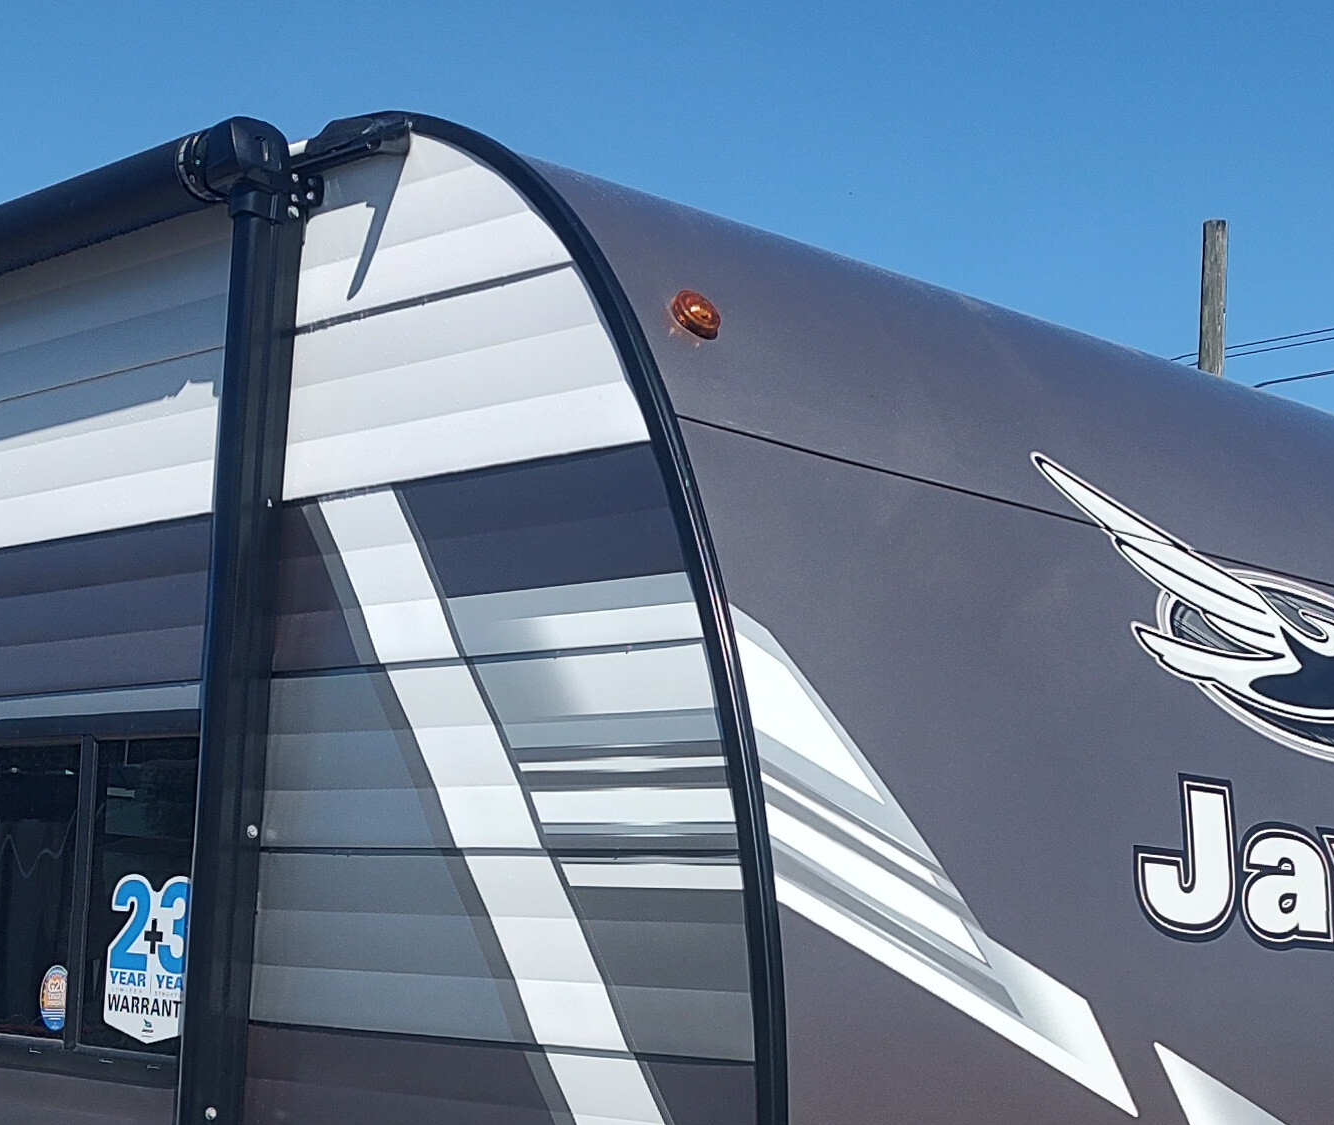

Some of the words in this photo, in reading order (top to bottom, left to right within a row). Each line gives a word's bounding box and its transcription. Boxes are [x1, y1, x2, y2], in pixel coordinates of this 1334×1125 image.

[110, 970, 146, 987] YEAR
[156, 974, 184, 991] YEA
[108, 993, 182, 1018] WARRANT
